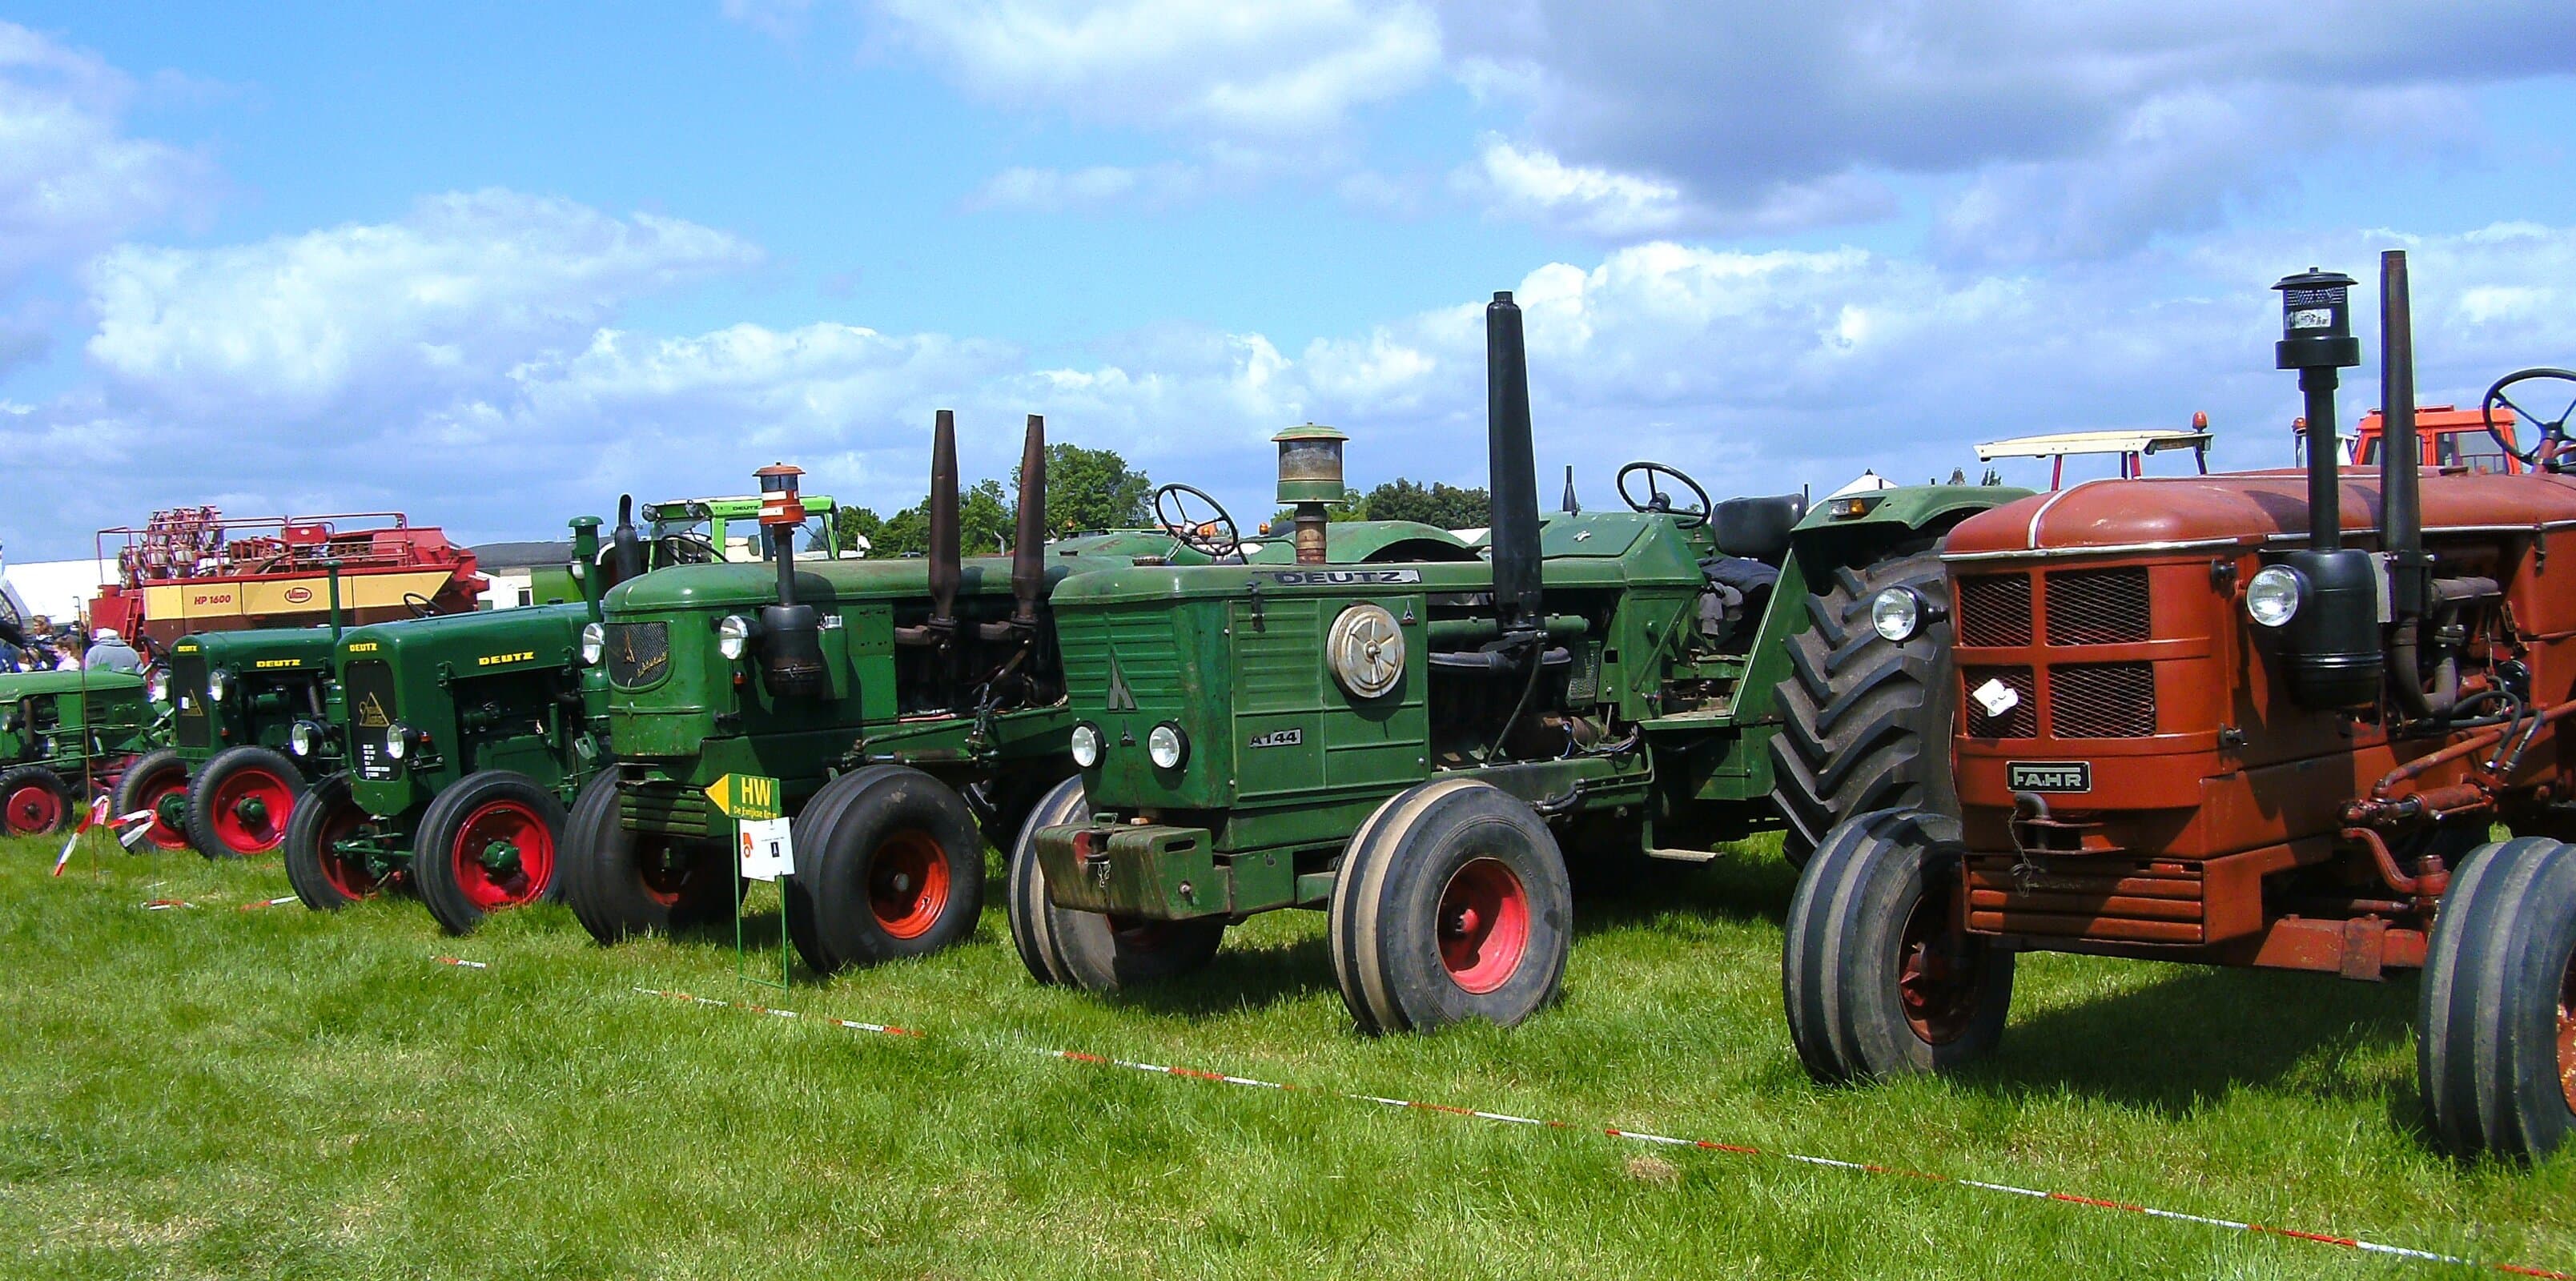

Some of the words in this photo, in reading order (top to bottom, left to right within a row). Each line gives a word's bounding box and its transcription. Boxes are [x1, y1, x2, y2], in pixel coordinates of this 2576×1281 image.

[1274, 571, 1403, 584] DEUTZ
[194, 596, 207, 604] HP
[210, 595, 231, 604] 1600
[349, 643, 377, 652] DEUTZ
[256, 659, 301, 668] DEUTZ
[479, 652, 535, 665] DEUTZ
[2013, 767, 2081, 787] FAHR
[741, 777, 771, 807] HW
